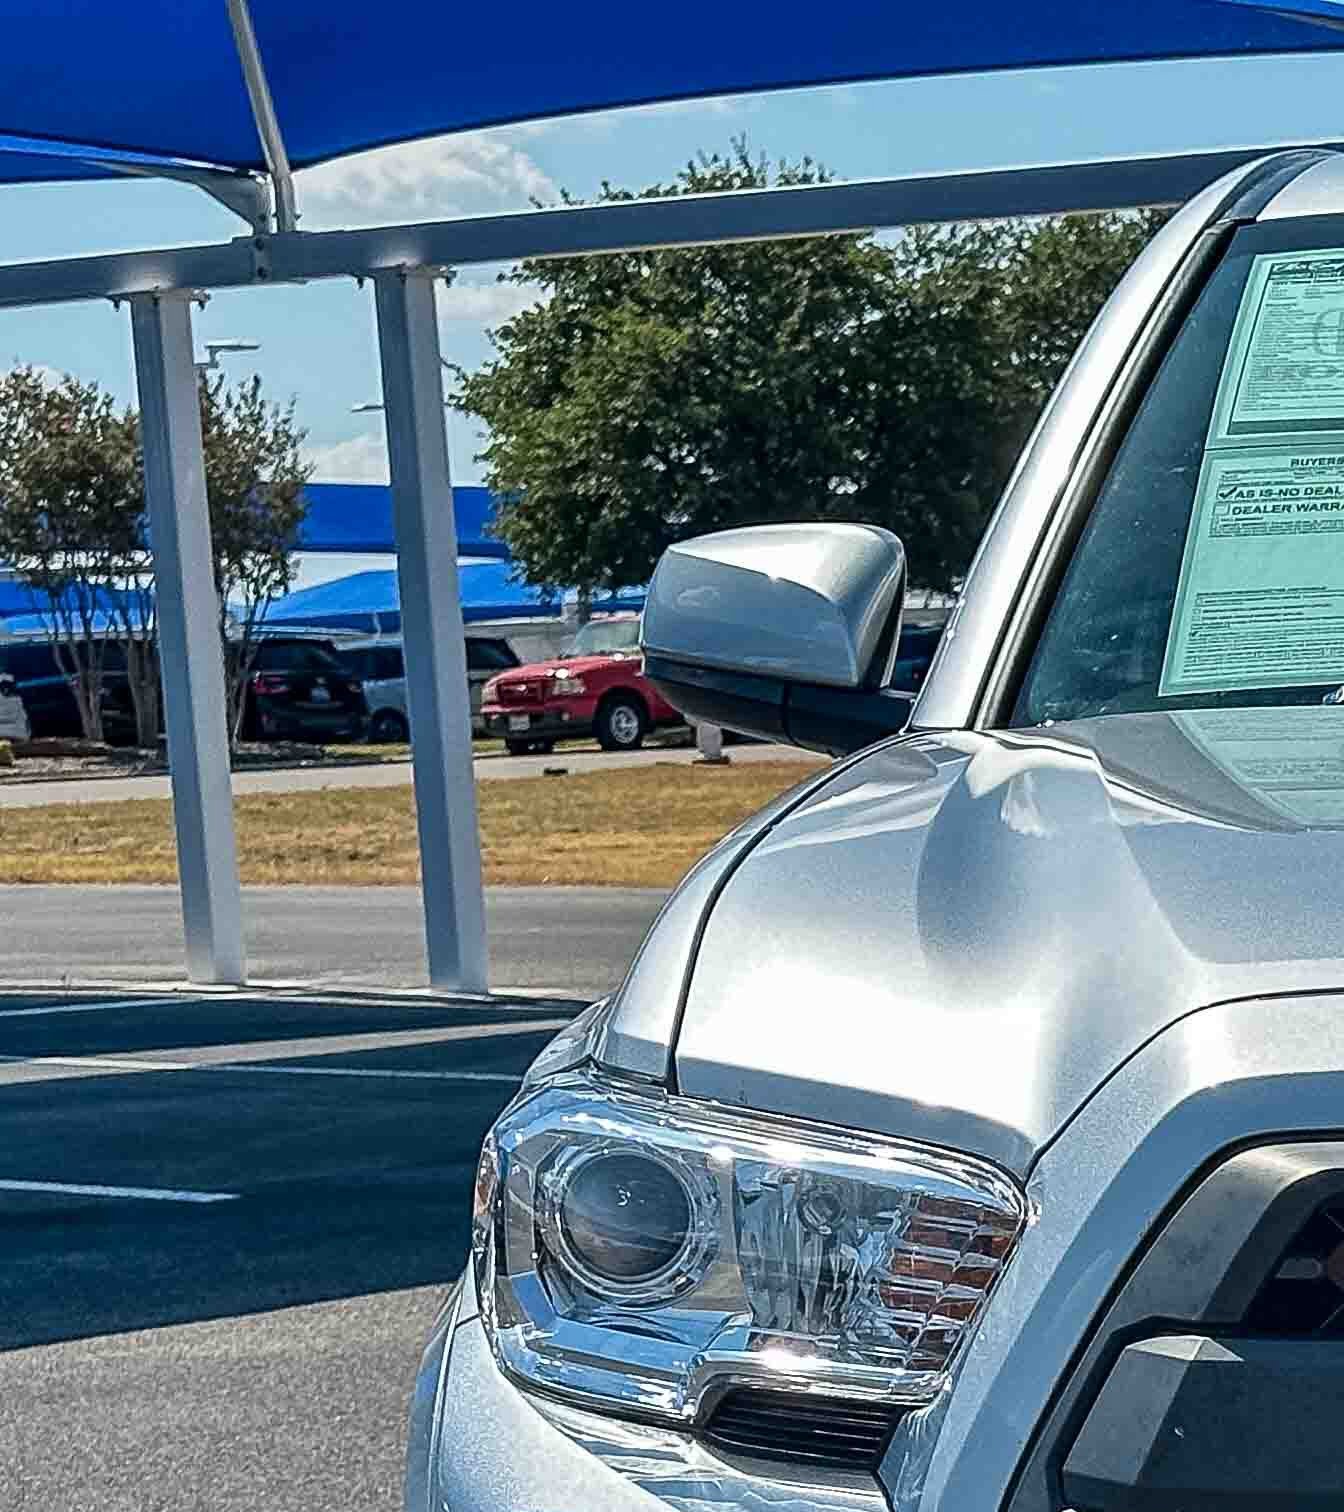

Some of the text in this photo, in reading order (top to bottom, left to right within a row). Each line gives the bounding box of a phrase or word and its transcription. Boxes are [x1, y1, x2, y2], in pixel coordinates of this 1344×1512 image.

[1290, 457, 1344, 468] BUYERS
[1236, 489, 1255, 499] AS
[1232, 503, 1292, 516] DEALER
